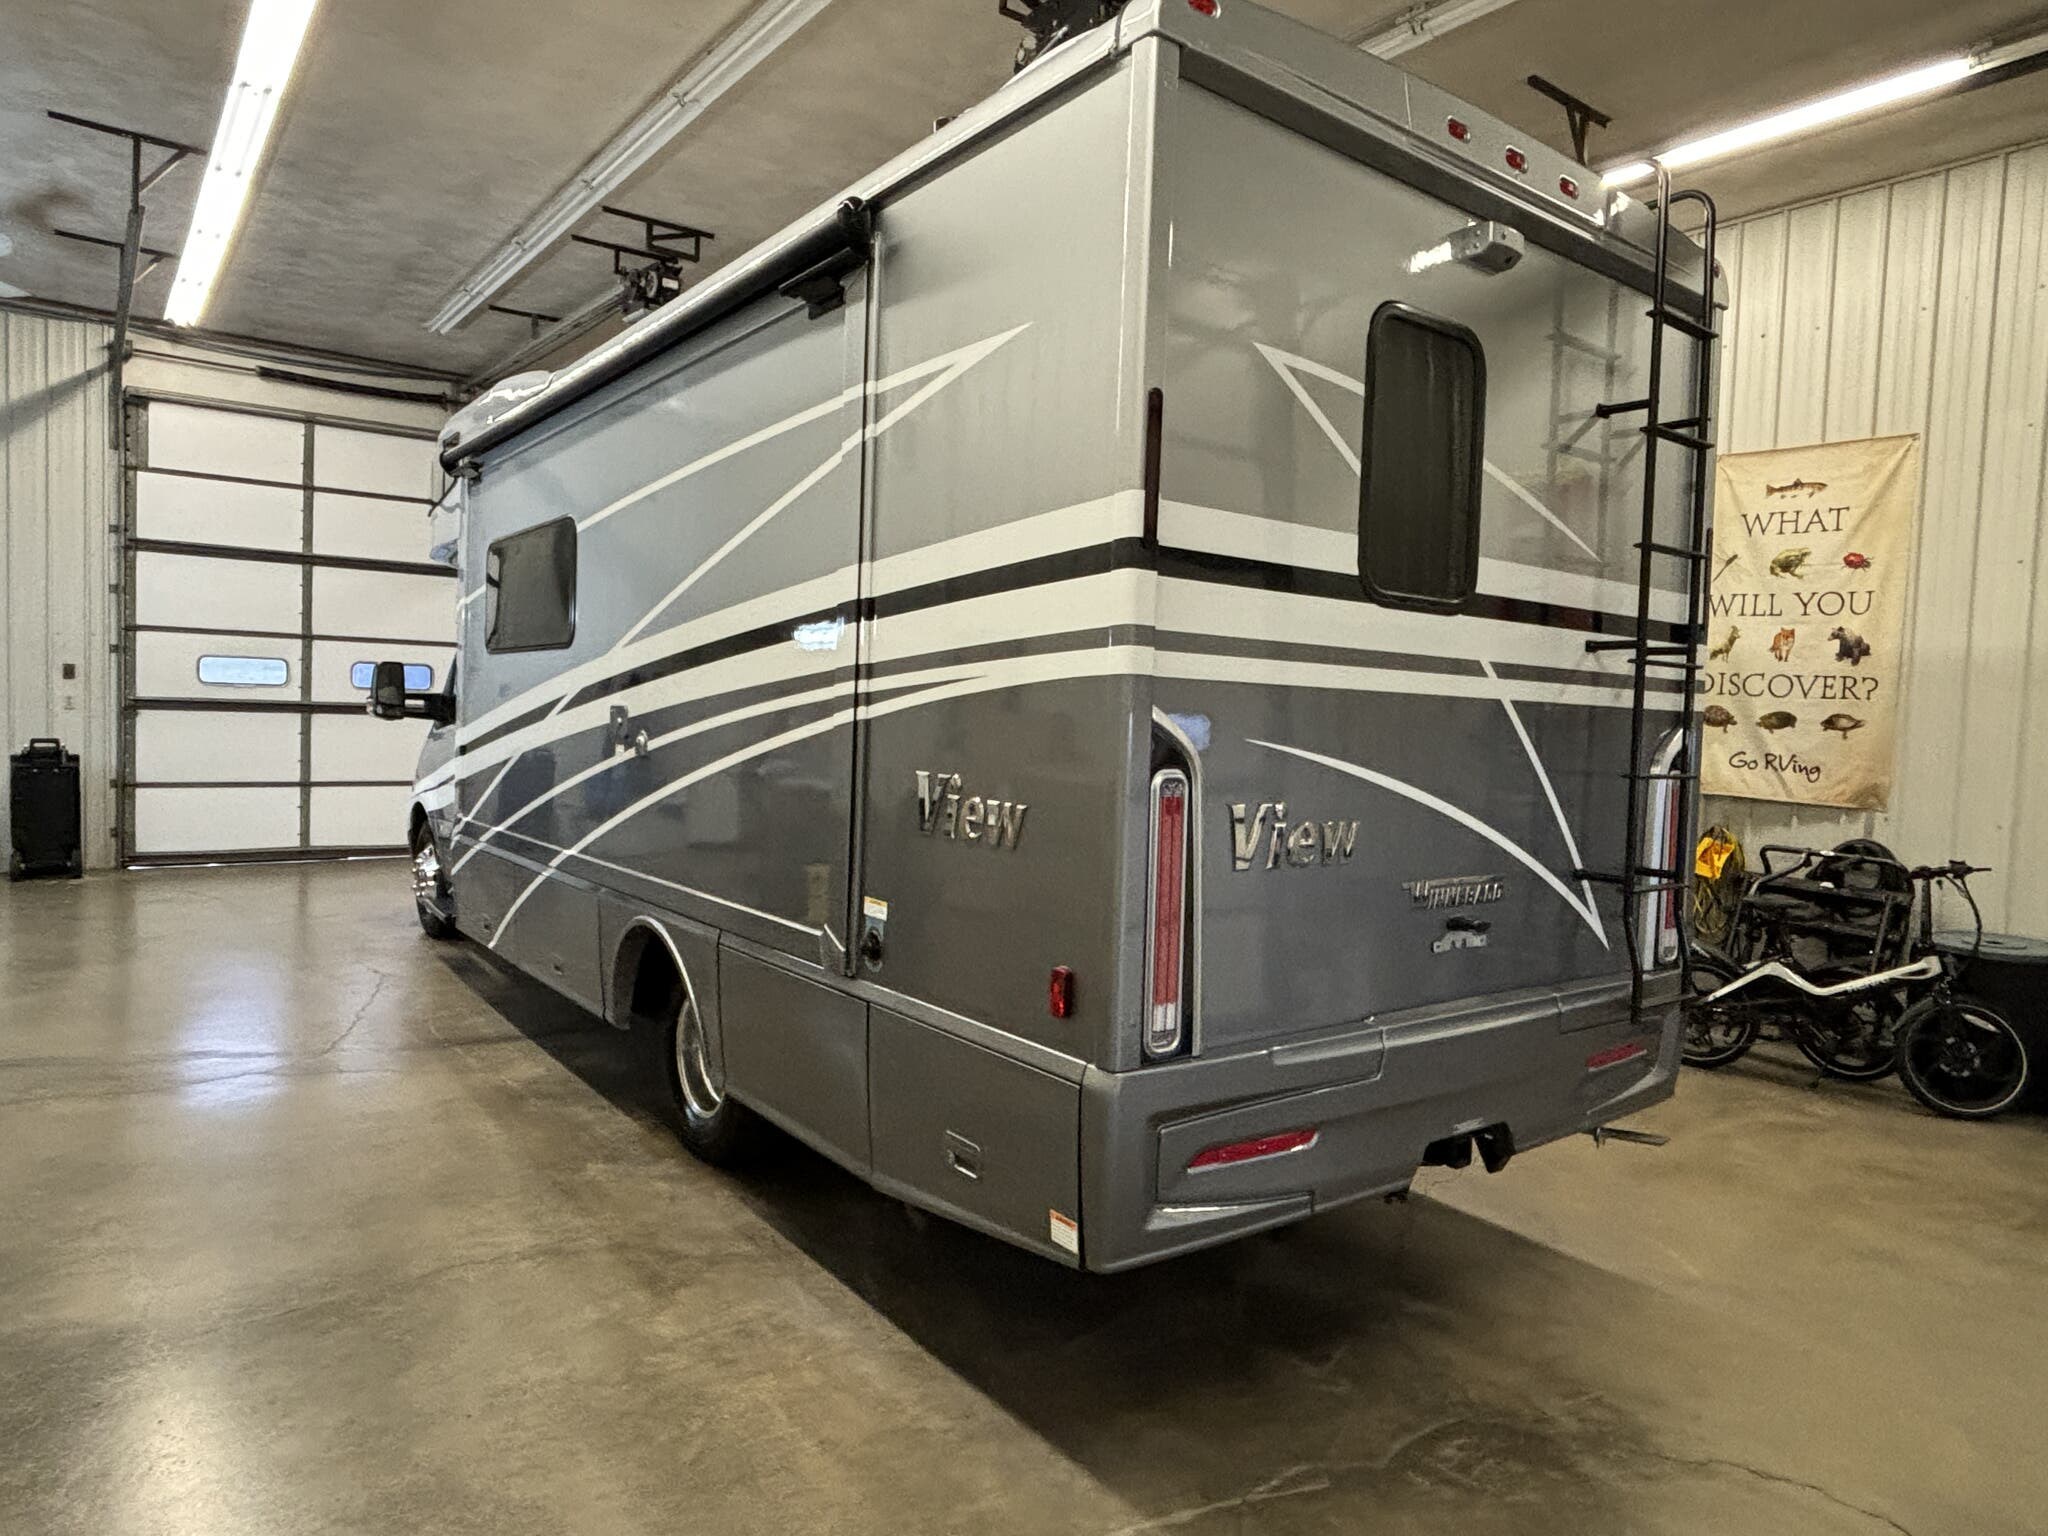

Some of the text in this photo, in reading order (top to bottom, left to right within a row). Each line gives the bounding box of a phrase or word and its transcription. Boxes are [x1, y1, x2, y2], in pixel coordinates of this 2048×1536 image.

[1740, 506, 1850, 538] WHAT
[1709, 590, 1876, 617] WILL YOU
[1728, 751, 1821, 783] Go RVing
[915, 769, 1028, 850] View
[1226, 800, 1360, 871] View
